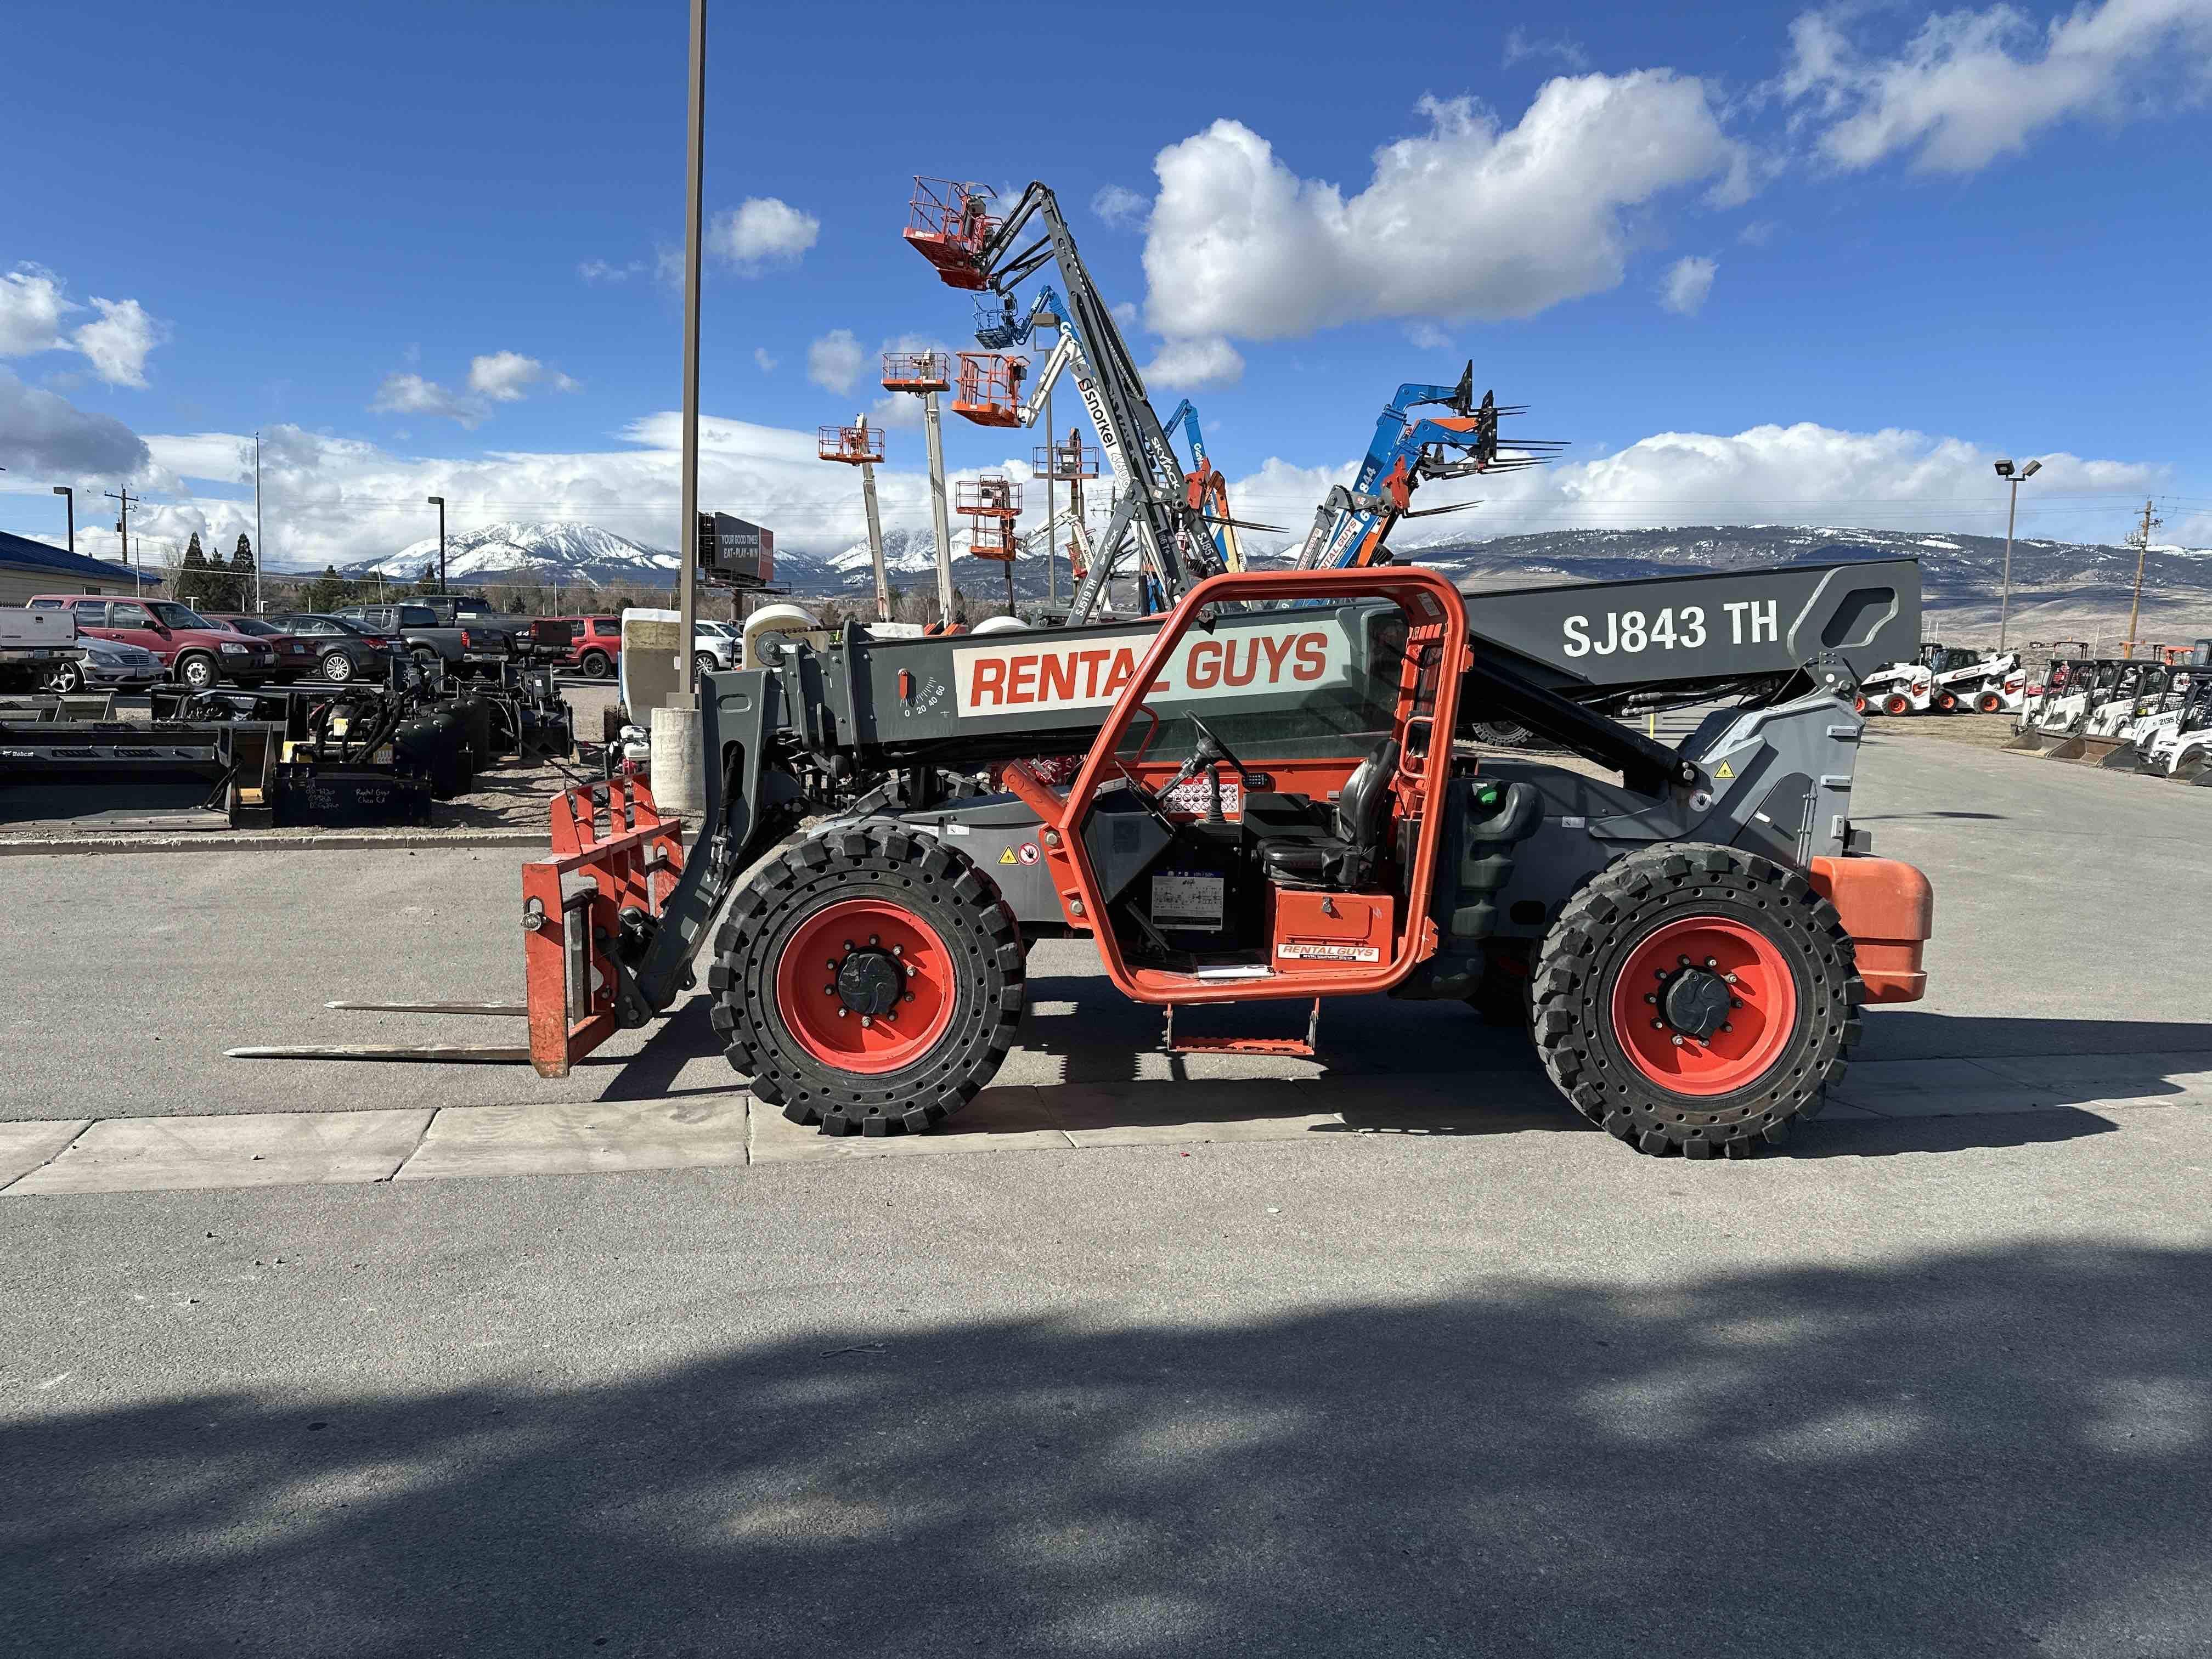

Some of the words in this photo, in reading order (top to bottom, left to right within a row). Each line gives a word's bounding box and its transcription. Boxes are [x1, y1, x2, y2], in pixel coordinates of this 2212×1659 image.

[1085, 390, 1117, 448] snorkel
[1152, 437, 1180, 489] SKYJACK
[1359, 466, 1376, 493] 844
[721, 534, 734, 545] YOUR
[735, 534, 746, 545] GOOD
[724, 548, 733, 558] EAT
[736, 548, 747, 558] PLAY
[1197, 532, 1214, 558] SJ85
[1321, 549, 1338, 569] NTAL
[1338, 520, 1357, 547] GUYS
[1300, 550, 1310, 570] NTAL
[1075, 591, 1092, 616] SJ519
[1086, 578, 1097, 590] TH
[1563, 606, 1706, 657] SJ843
[1723, 600, 1778, 645] TH
[1186, 632, 1328, 690] GUYS
[916, 704, 927, 714] 20
[928, 697, 938, 707] 40
[935, 686, 945, 696] 60
[2159, 716, 2175, 725] 2135
[1283, 946, 1334, 955] RENTAL
[1337, 948, 1374, 956] GUYS
